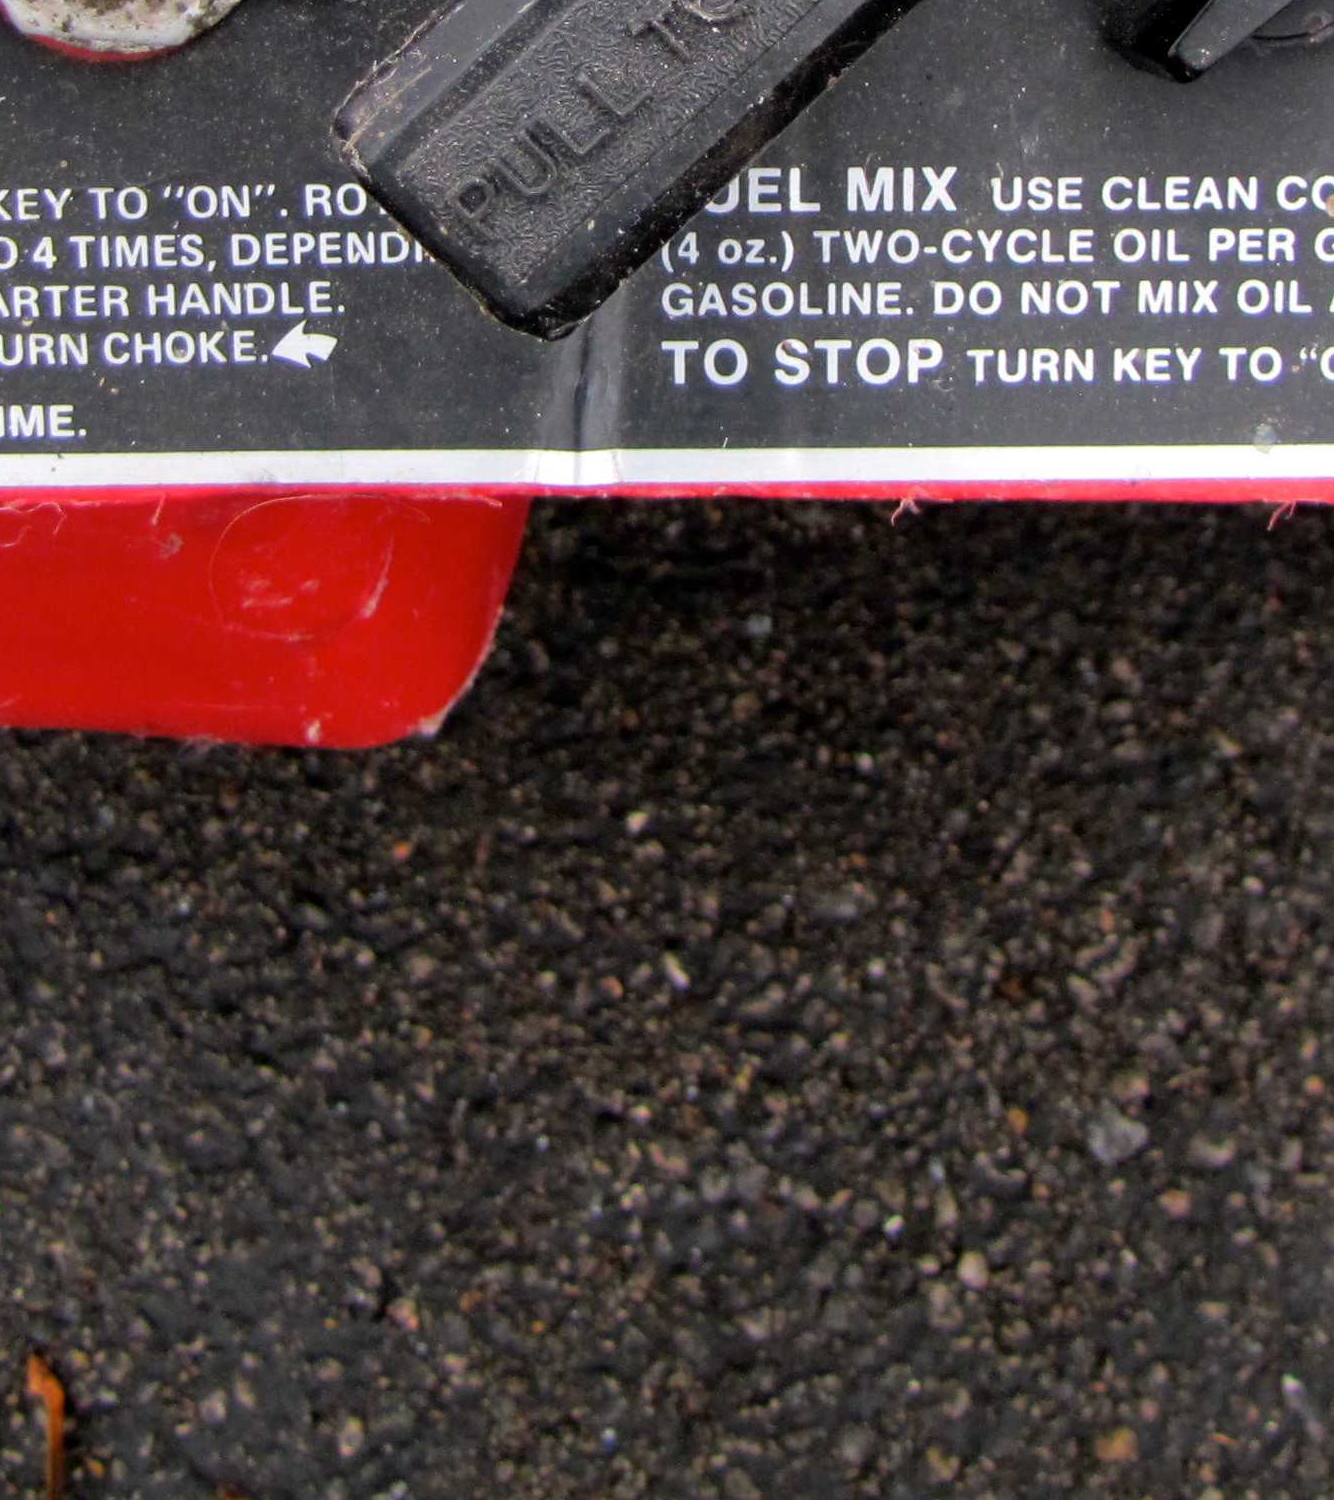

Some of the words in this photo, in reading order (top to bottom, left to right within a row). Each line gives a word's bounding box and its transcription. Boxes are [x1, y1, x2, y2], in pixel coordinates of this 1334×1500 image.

[445, 72, 653, 238] PULL
[87, 186, 148, 220] TO
[304, 182, 387, 217] RO
[704, 166, 821, 214] UEL
[847, 166, 958, 212] MIX
[990, 176, 1083, 212] USE
[1101, 176, 1258, 211] CLEAN
[32, 236, 57, 270] 4
[68, 233, 217, 273] TIMES,
[230, 231, 436, 267] DEPENDI
[661, 231, 700, 274] (4
[717, 230, 795, 273] oz.)
[812, 228, 1094, 264] TWO-CYCLE
[1113, 228, 1190, 263] OIL
[1208, 227, 1296, 262] PER
[147, 280, 345, 317] HANDLE.
[661, 281, 914, 318] GASOLINE.
[933, 280, 1002, 316] DO
[1021, 279, 1121, 315] NOT
[1138, 280, 1219, 314] MIX
[1237, 279, 1313, 315] OIL
[103, 330, 268, 365] CHOKE.
[661, 338, 748, 386] TO
[774, 338, 944, 386] STOP
[966, 348, 1094, 383] TURN
[1113, 347, 1202, 382] KEY
[1218, 346, 1283, 382] TO
